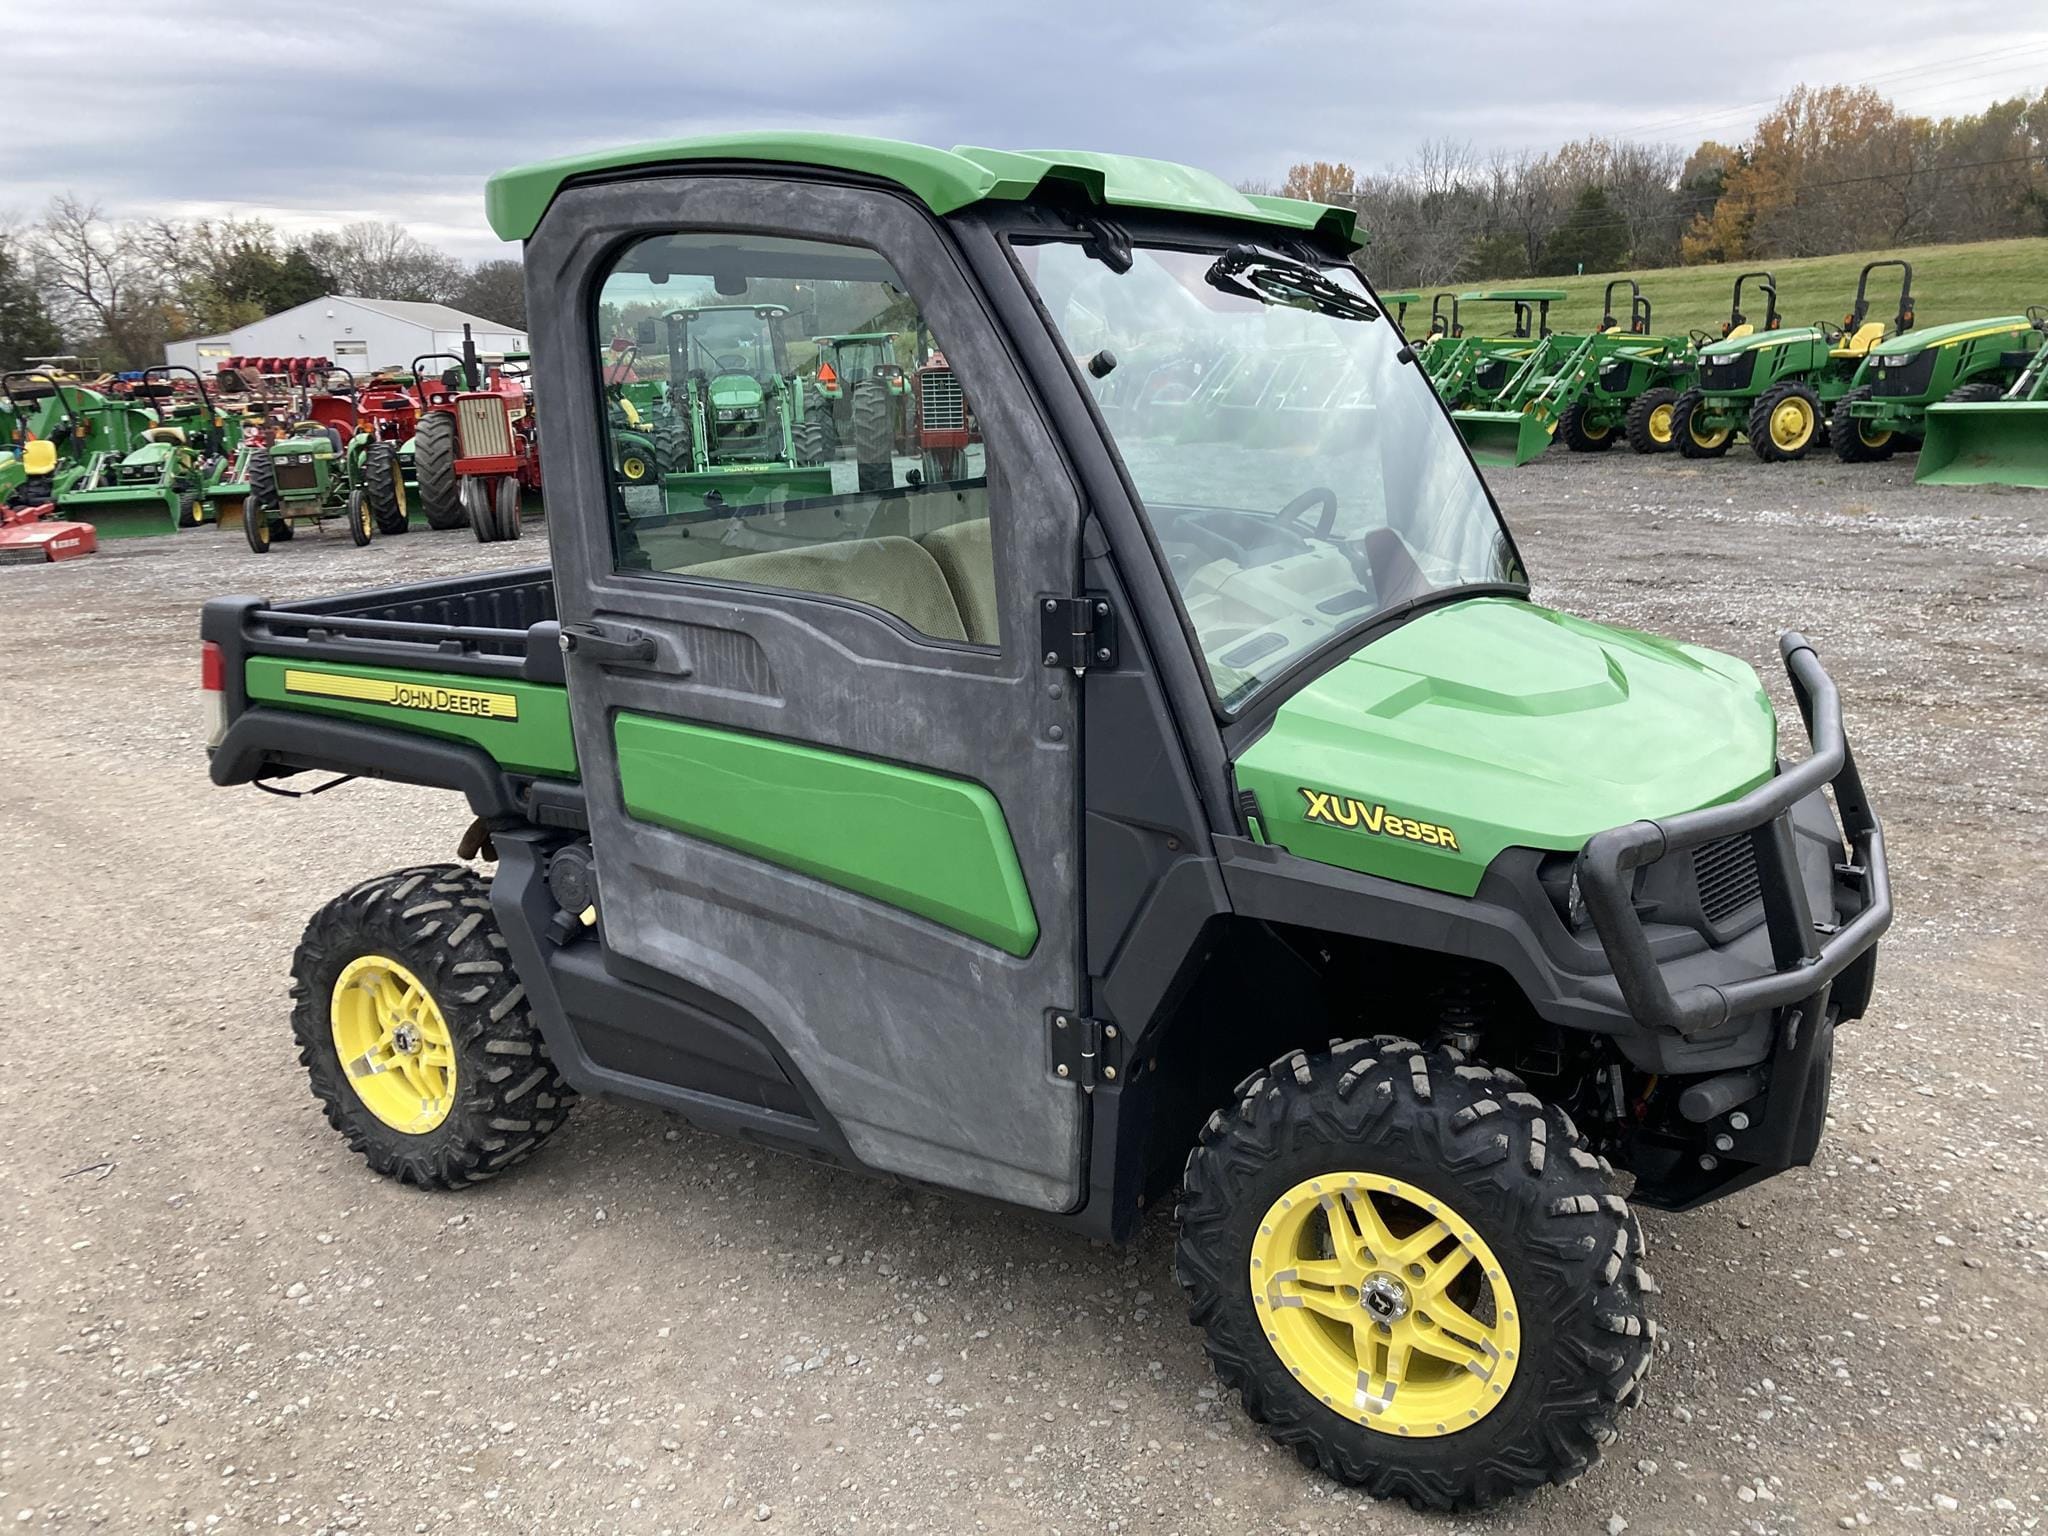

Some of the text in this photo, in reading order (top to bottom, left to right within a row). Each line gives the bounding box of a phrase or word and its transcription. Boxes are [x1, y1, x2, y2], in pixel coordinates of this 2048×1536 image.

[390, 685, 491, 713] JOHN DEERE
[1302, 788, 1459, 850] XUV835R
